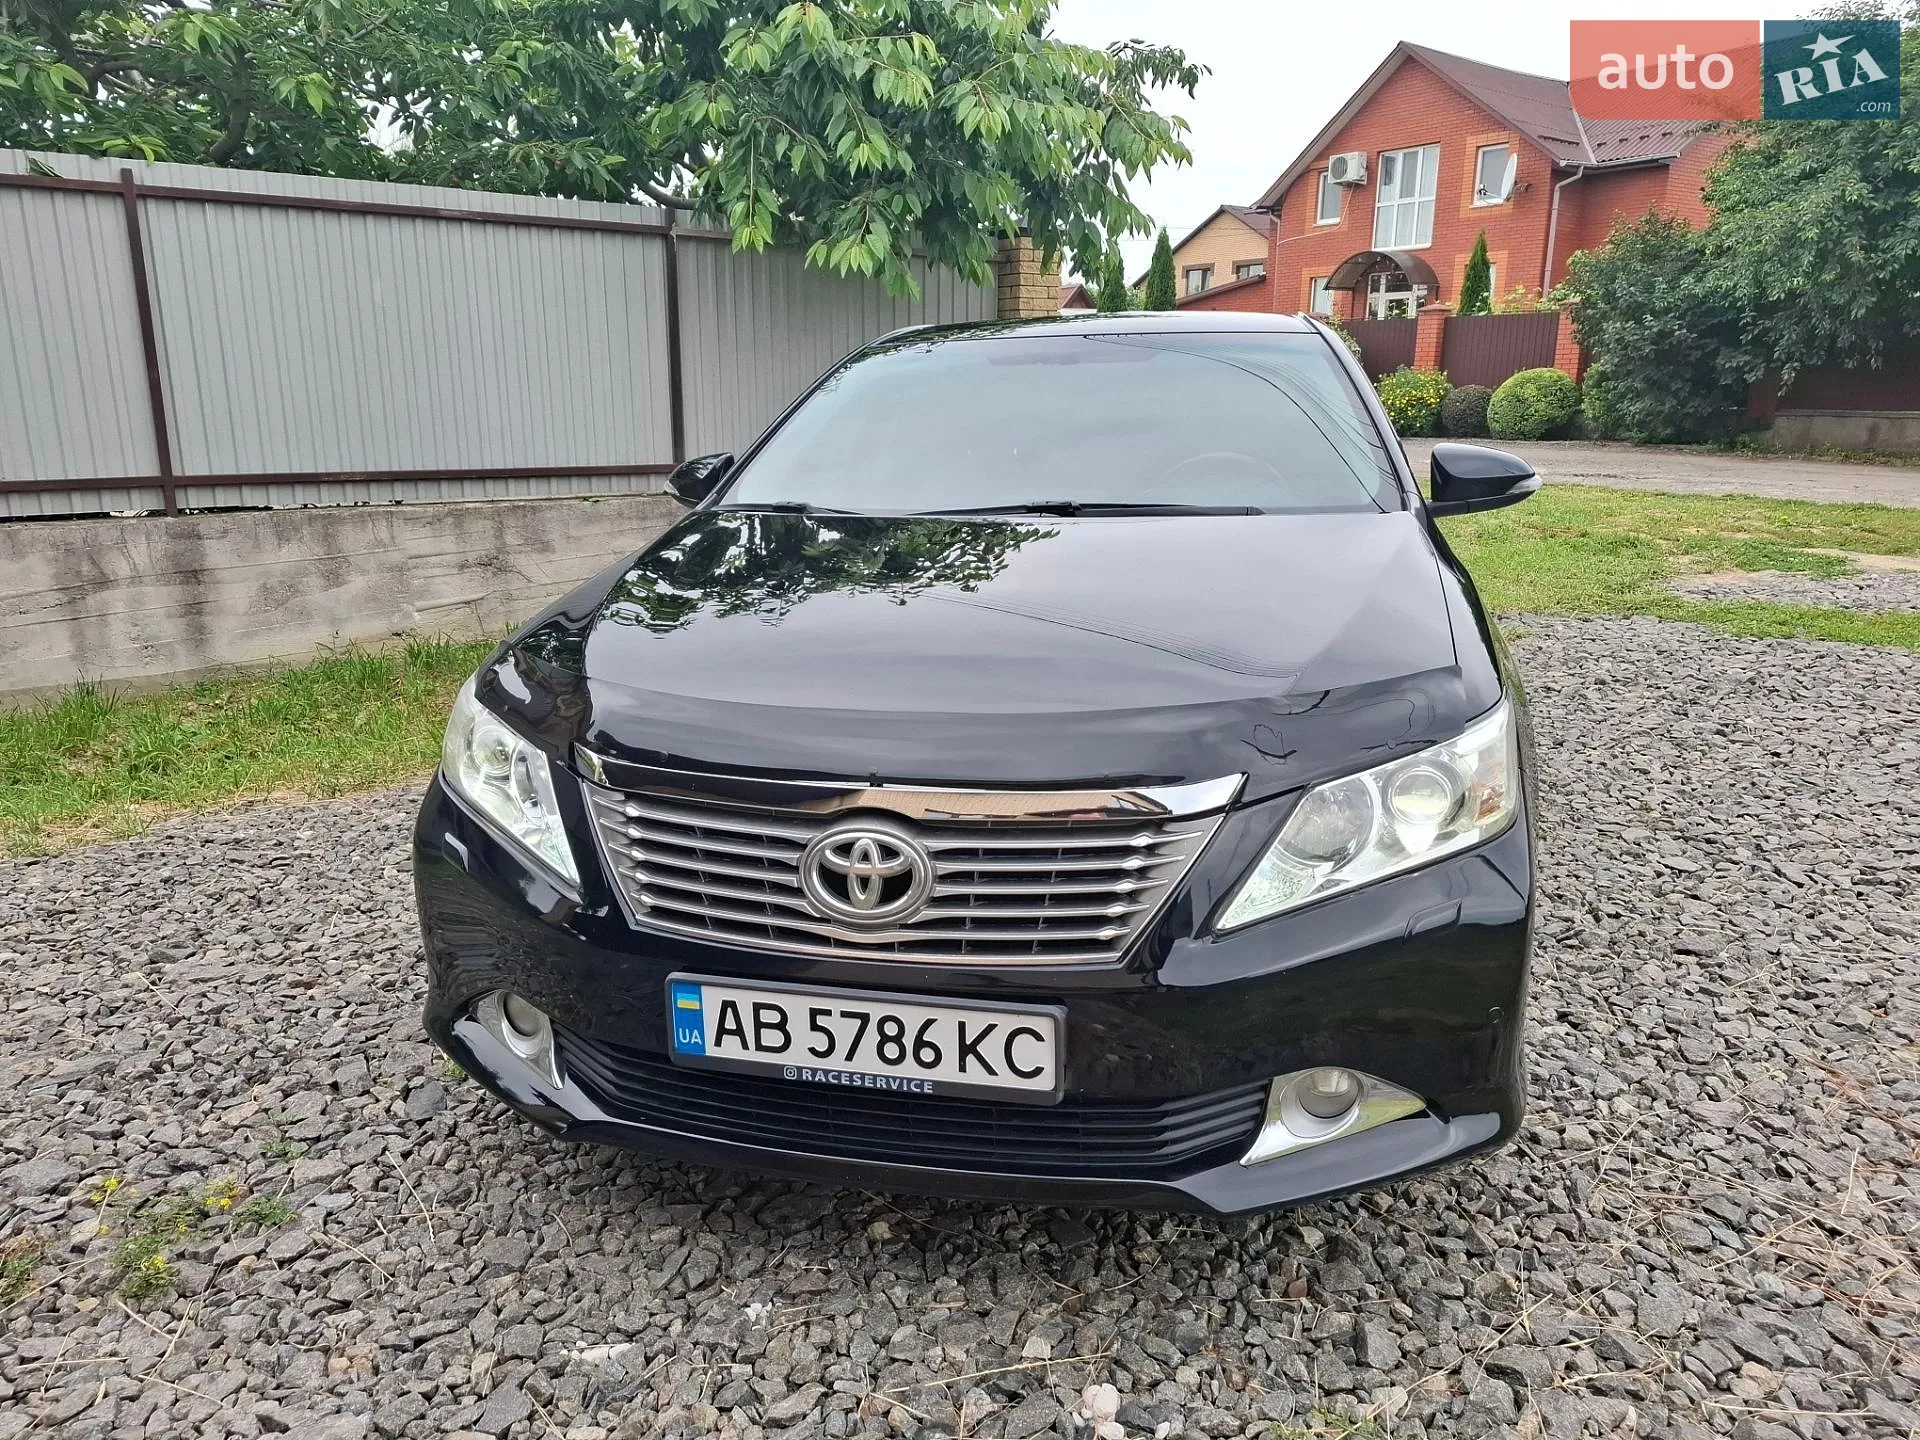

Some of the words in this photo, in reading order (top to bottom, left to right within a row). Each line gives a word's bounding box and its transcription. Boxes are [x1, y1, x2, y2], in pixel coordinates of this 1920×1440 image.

[679, 1029, 703, 1045] UA
[713, 999, 792, 1054] AB
[807, 1006, 943, 1070] 5786
[957, 1020, 1046, 1079] KC
[802, 1068, 935, 1094] RACESERVICE
